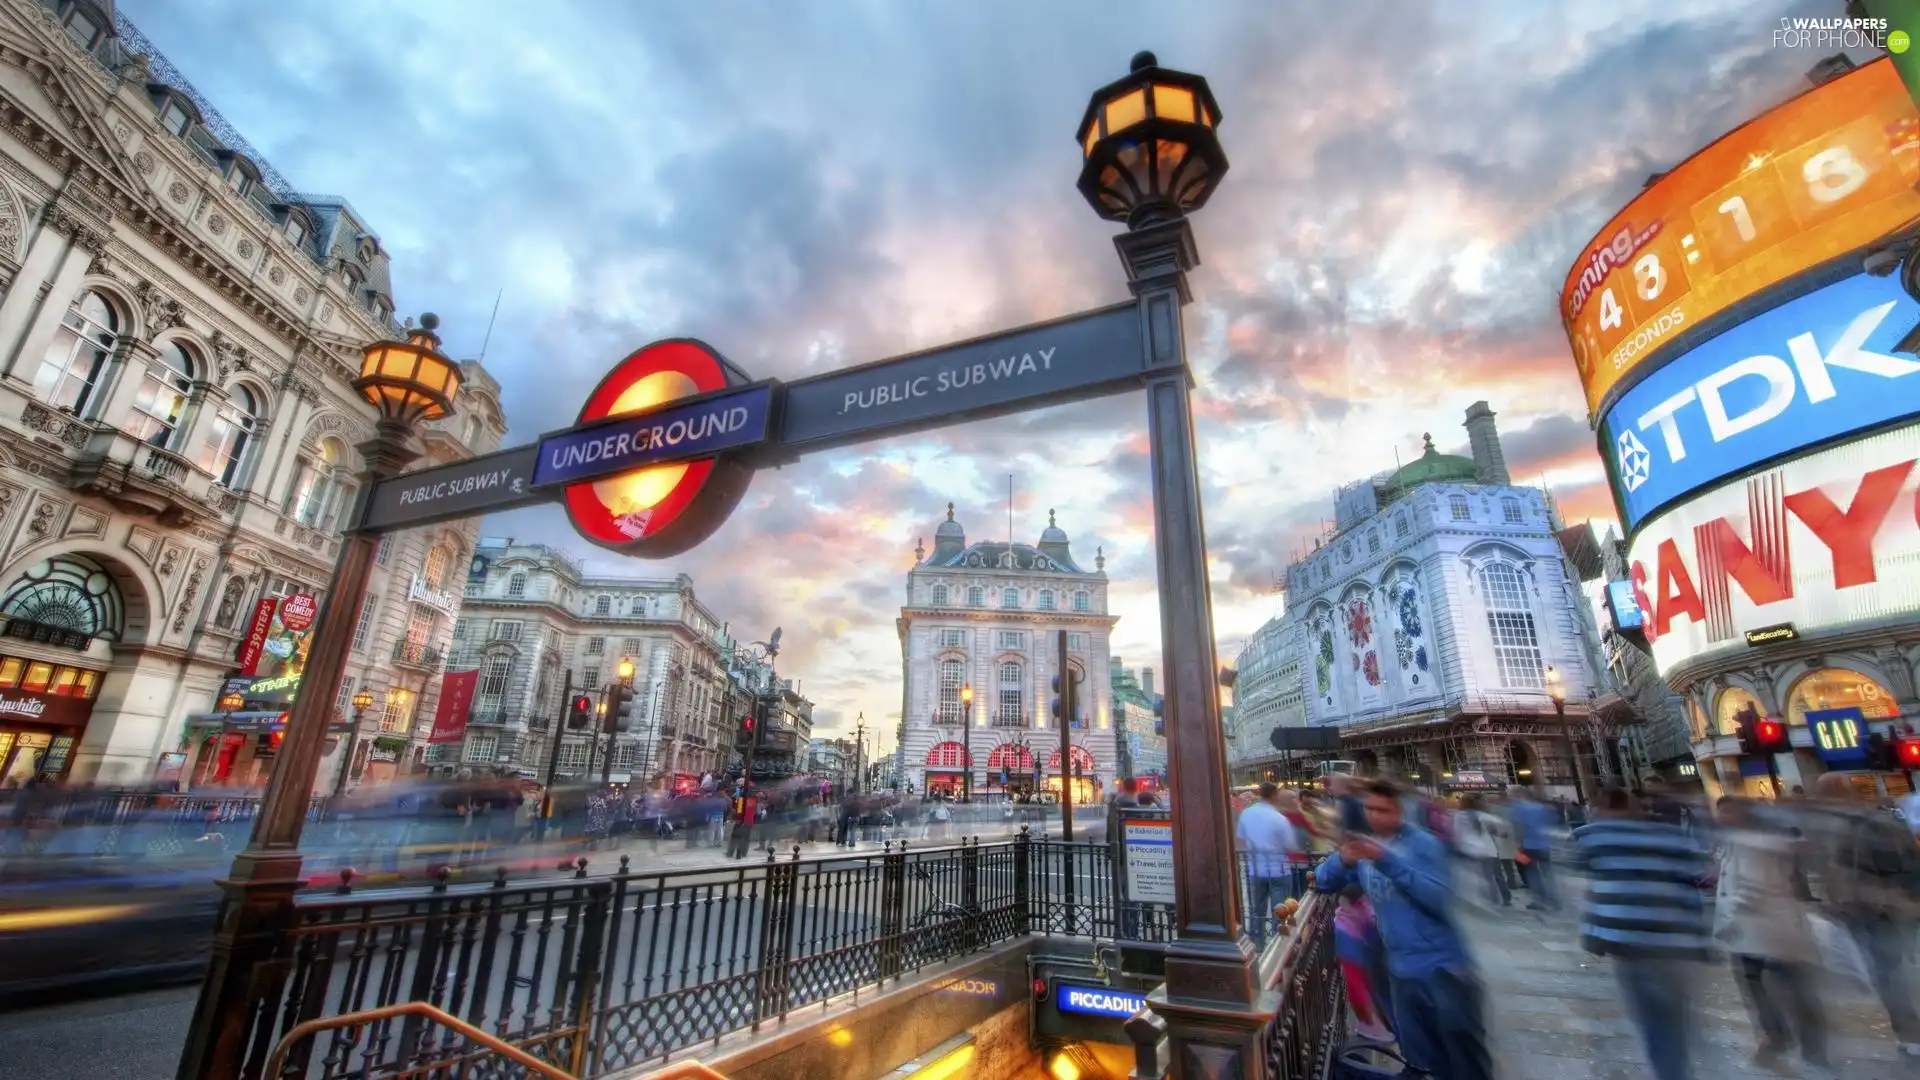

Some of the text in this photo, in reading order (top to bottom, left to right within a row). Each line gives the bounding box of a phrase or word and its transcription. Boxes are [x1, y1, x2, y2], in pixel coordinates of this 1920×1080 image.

[1613, 306, 1685, 369] SECONDS
[842, 347, 1057, 413] PUBLIC SUBWAY
[1638, 299, 1920, 463] TDK
[551, 406, 749, 470] UNDERGROUND
[400, 468, 511, 505] PUBLIC SUBWAY
[1631, 457, 1920, 644] SANY
[285, 602, 315, 617] COMEDY
[294, 595, 312, 607] BEST
[251, 632, 262, 649] 39
[450, 677, 465, 723] SALE
[1815, 719, 1859, 750] GAP
[1680, 764, 1695, 776] GAP
[1070, 991, 1147, 1013] PICCADILL
